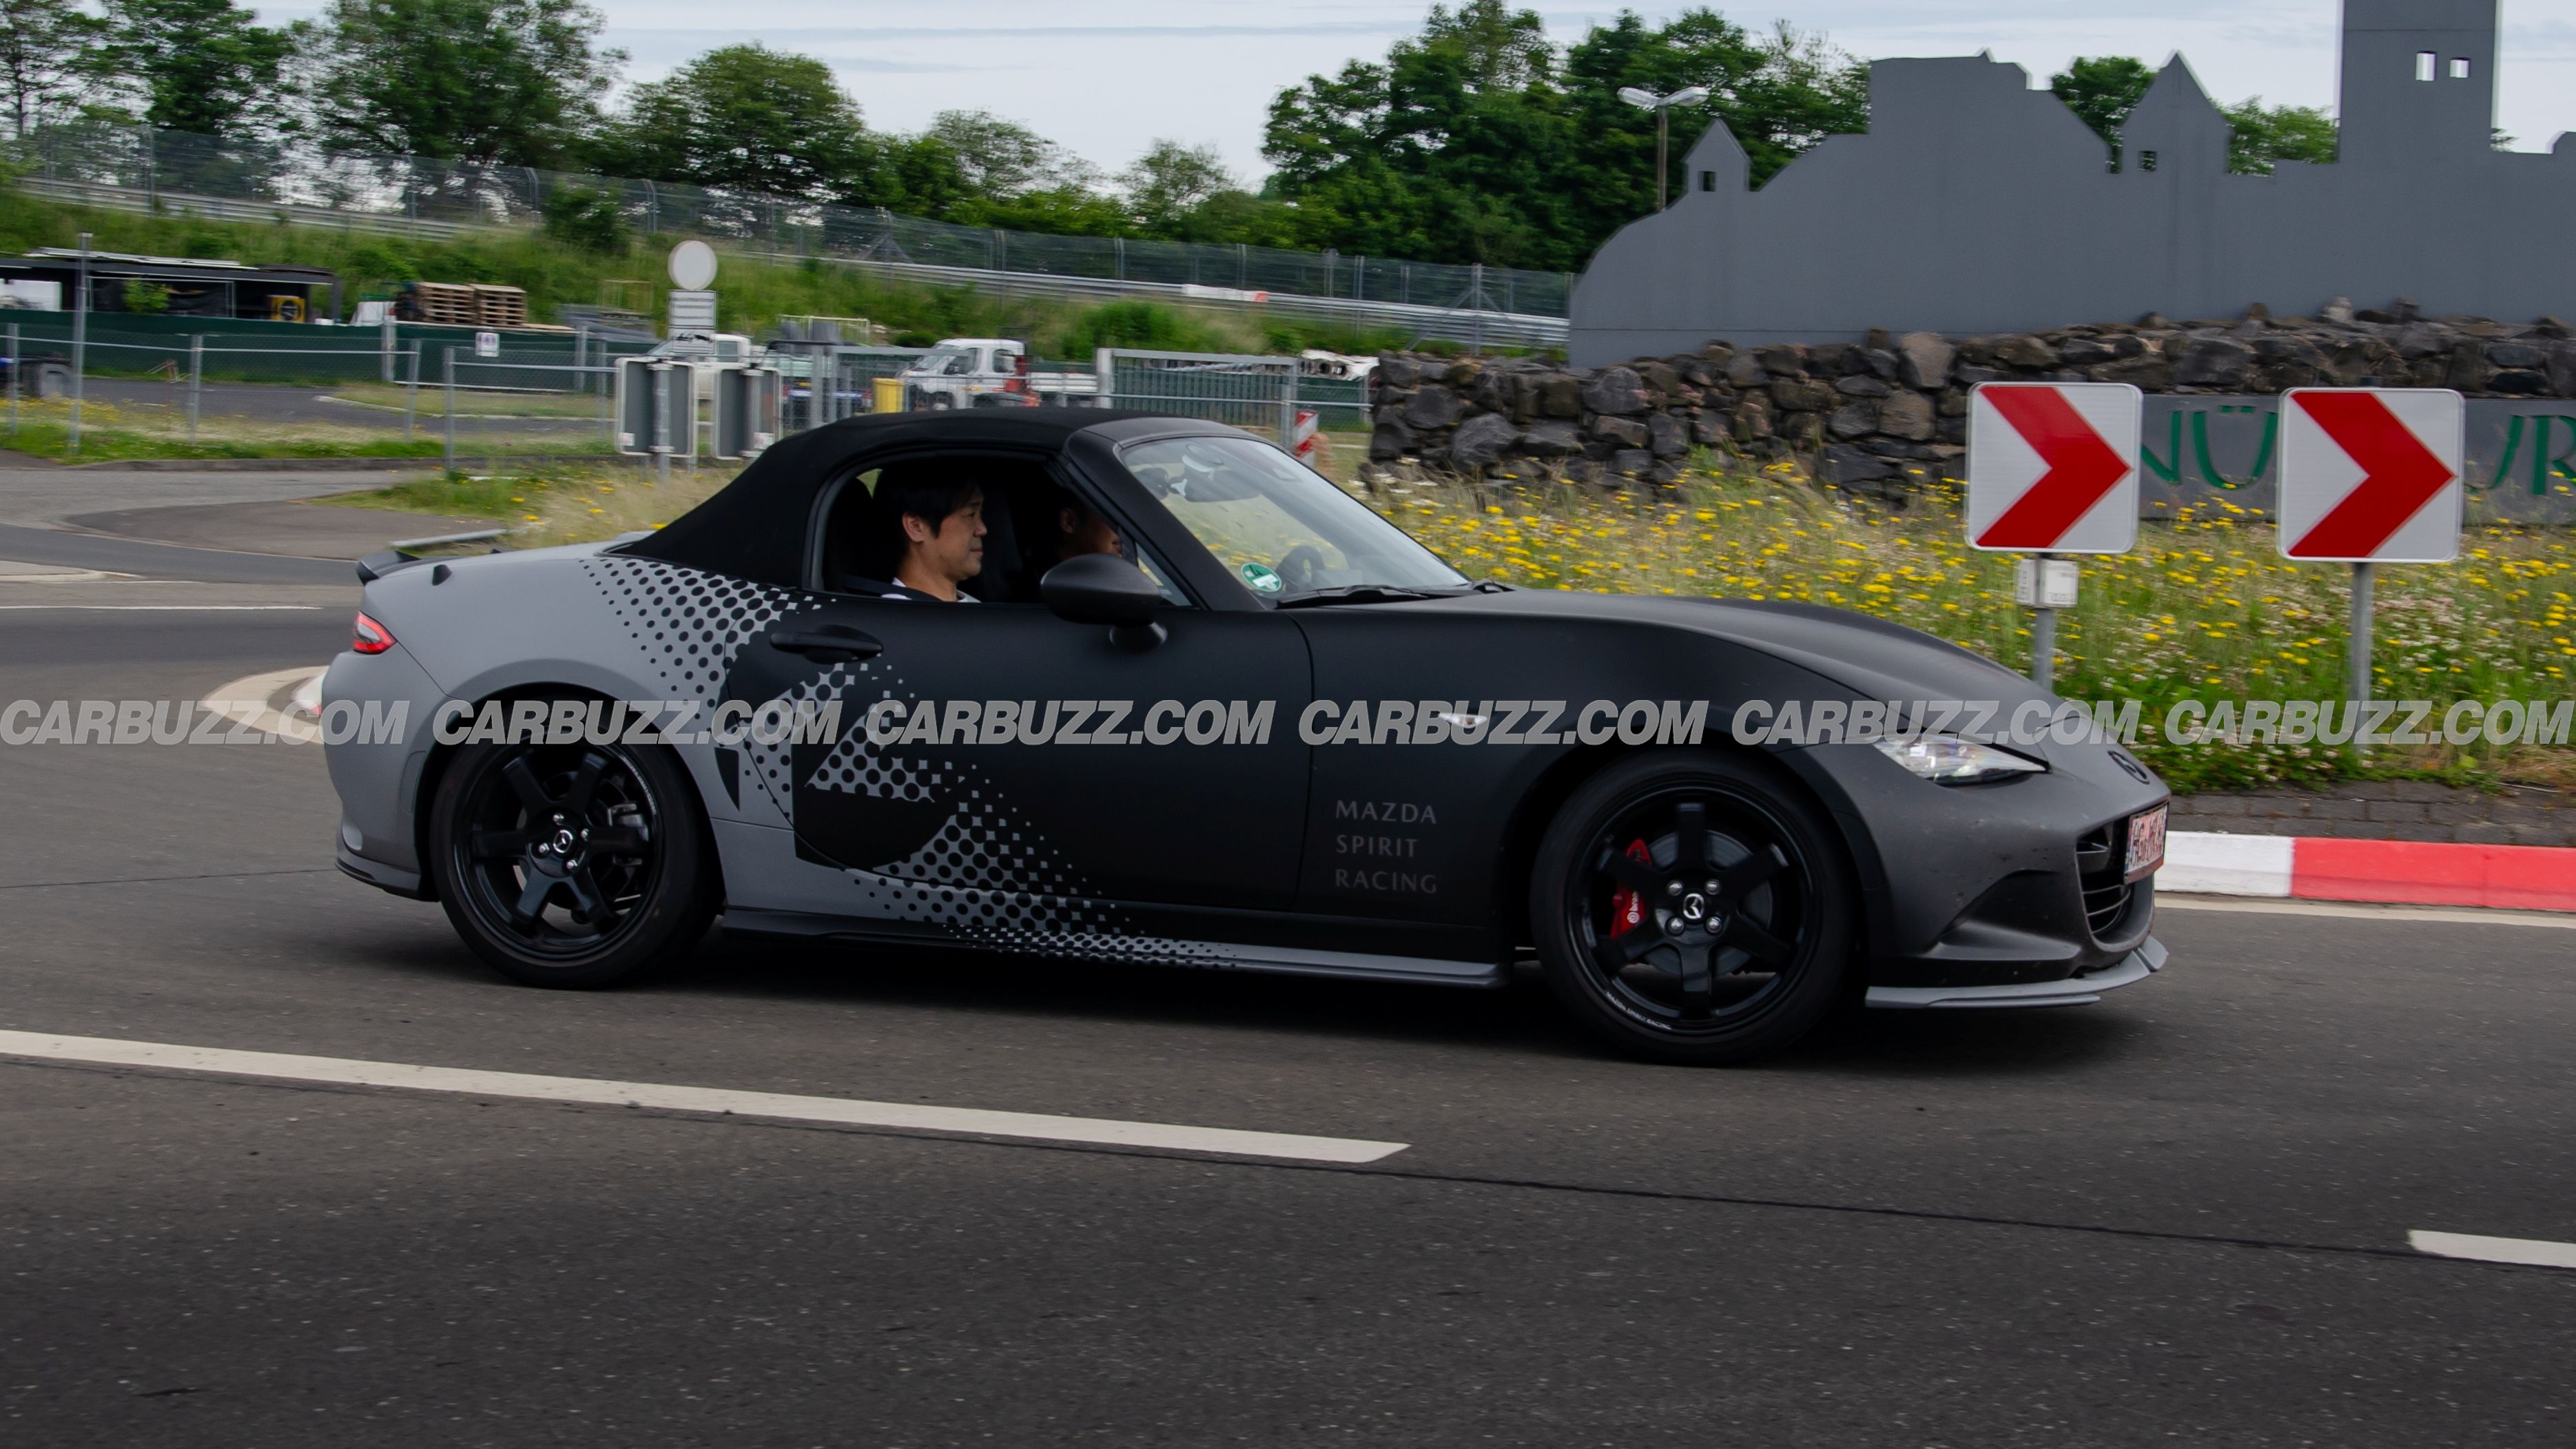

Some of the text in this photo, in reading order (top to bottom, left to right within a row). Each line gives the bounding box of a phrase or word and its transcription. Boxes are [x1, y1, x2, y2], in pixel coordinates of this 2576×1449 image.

[1335, 800, 1436, 824] MAZDA
[1336, 834, 1417, 857] SPIRIT
[1335, 869, 1436, 893] RACING
